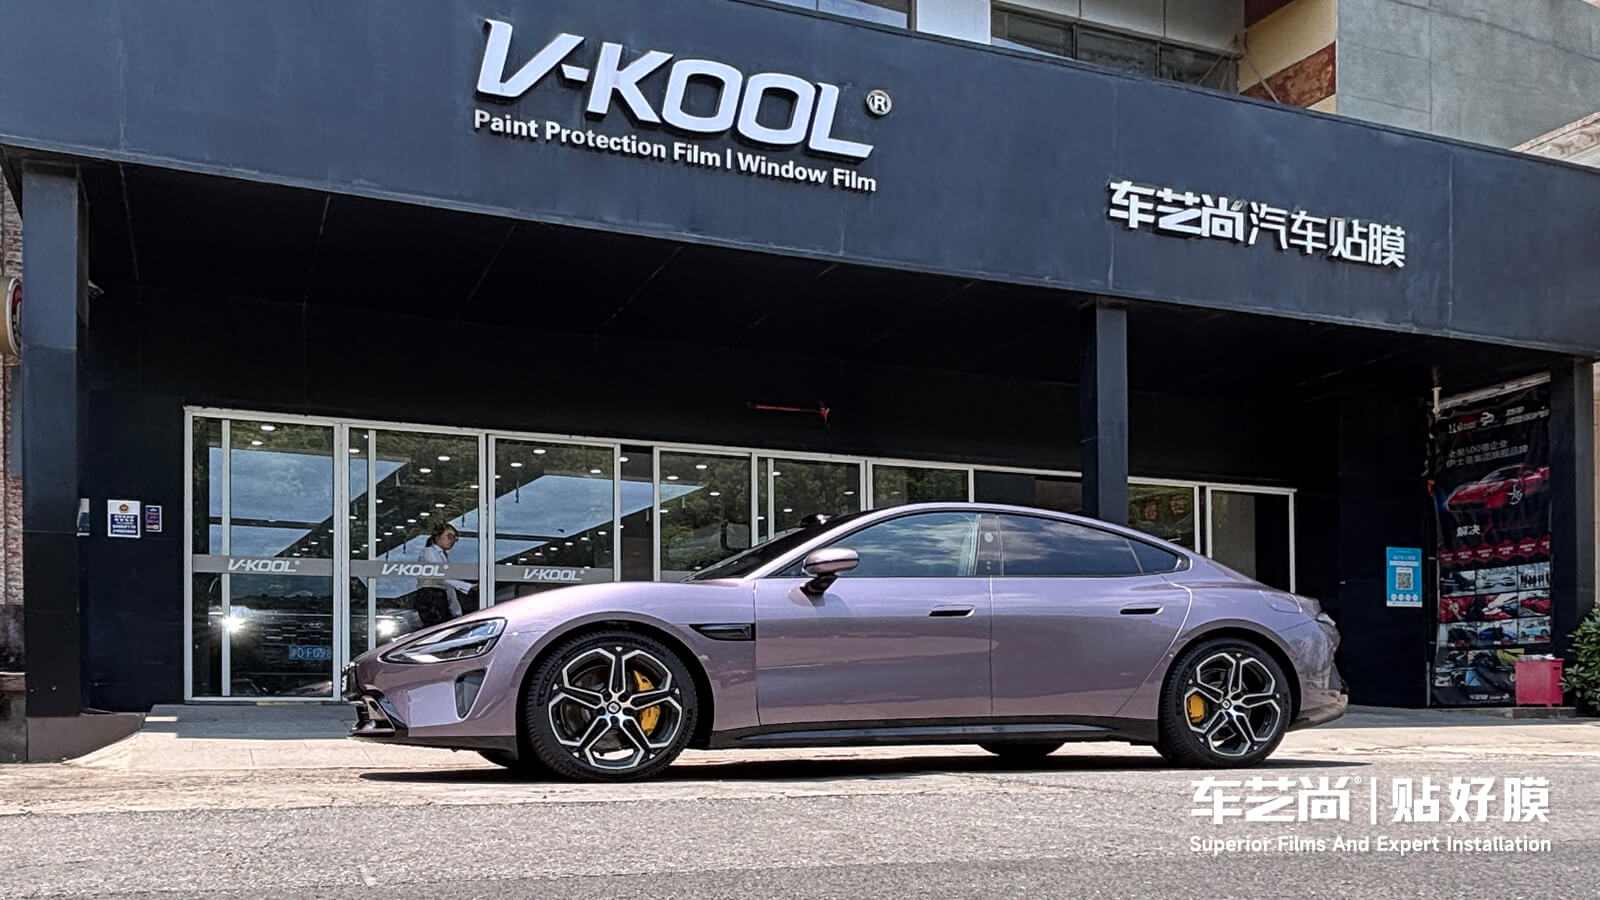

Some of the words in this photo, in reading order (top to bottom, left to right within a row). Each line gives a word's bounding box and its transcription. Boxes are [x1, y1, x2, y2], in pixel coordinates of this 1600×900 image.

[476, 18, 875, 158] V-KOOL
[474, 109, 538, 138] Paint
[545, 121, 666, 160] Protection
[673, 140, 721, 168] Film
[738, 151, 827, 185] Window
[832, 167, 877, 192] Film
[1109, 180, 1406, 268] 车艺尚汽车贴膜
[227, 558, 297, 572] V-KOOL
[382, 563, 446, 577] V-KOOL
[523, 568, 582, 581] V-KOOL
